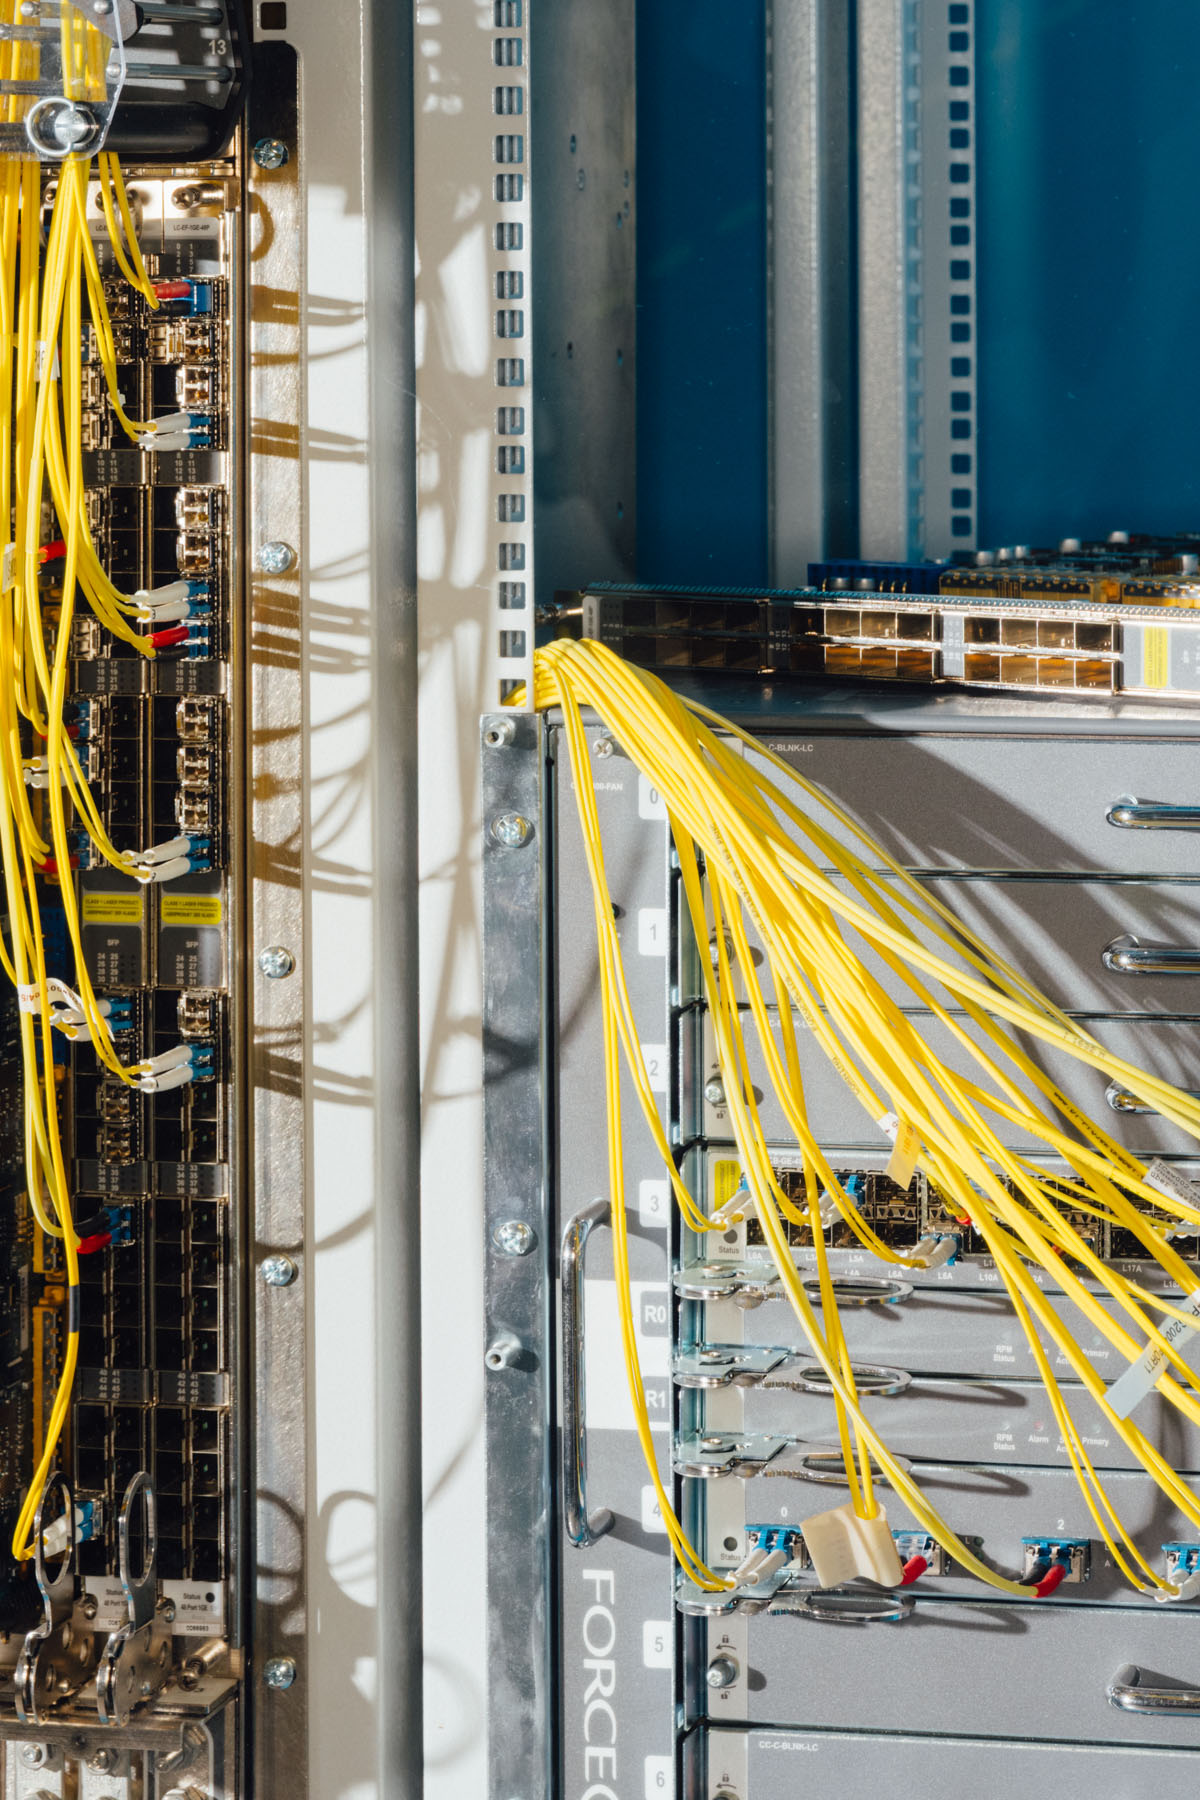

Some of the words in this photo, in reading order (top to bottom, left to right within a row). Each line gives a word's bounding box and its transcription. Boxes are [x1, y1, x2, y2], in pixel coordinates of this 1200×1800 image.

[208, 39, 227, 56] 13
[650, 790, 659, 804] 0
[650, 926, 658, 941] 1
[650, 1060, 659, 1077] 2
[650, 1195, 659, 1213] 3
[718, 1246, 740, 1254] Status
[644, 1305, 667, 1323] R0
[646, 1390, 667, 1408] R1
[1028, 1435, 1049, 1443] Alarm
[780, 1506, 788, 1518] 0
[1057, 1519, 1065, 1531] 2
[720, 1553, 741, 1561] Status
[654, 1636, 664, 1653] 5
[655, 1771, 666, 1788] 6
